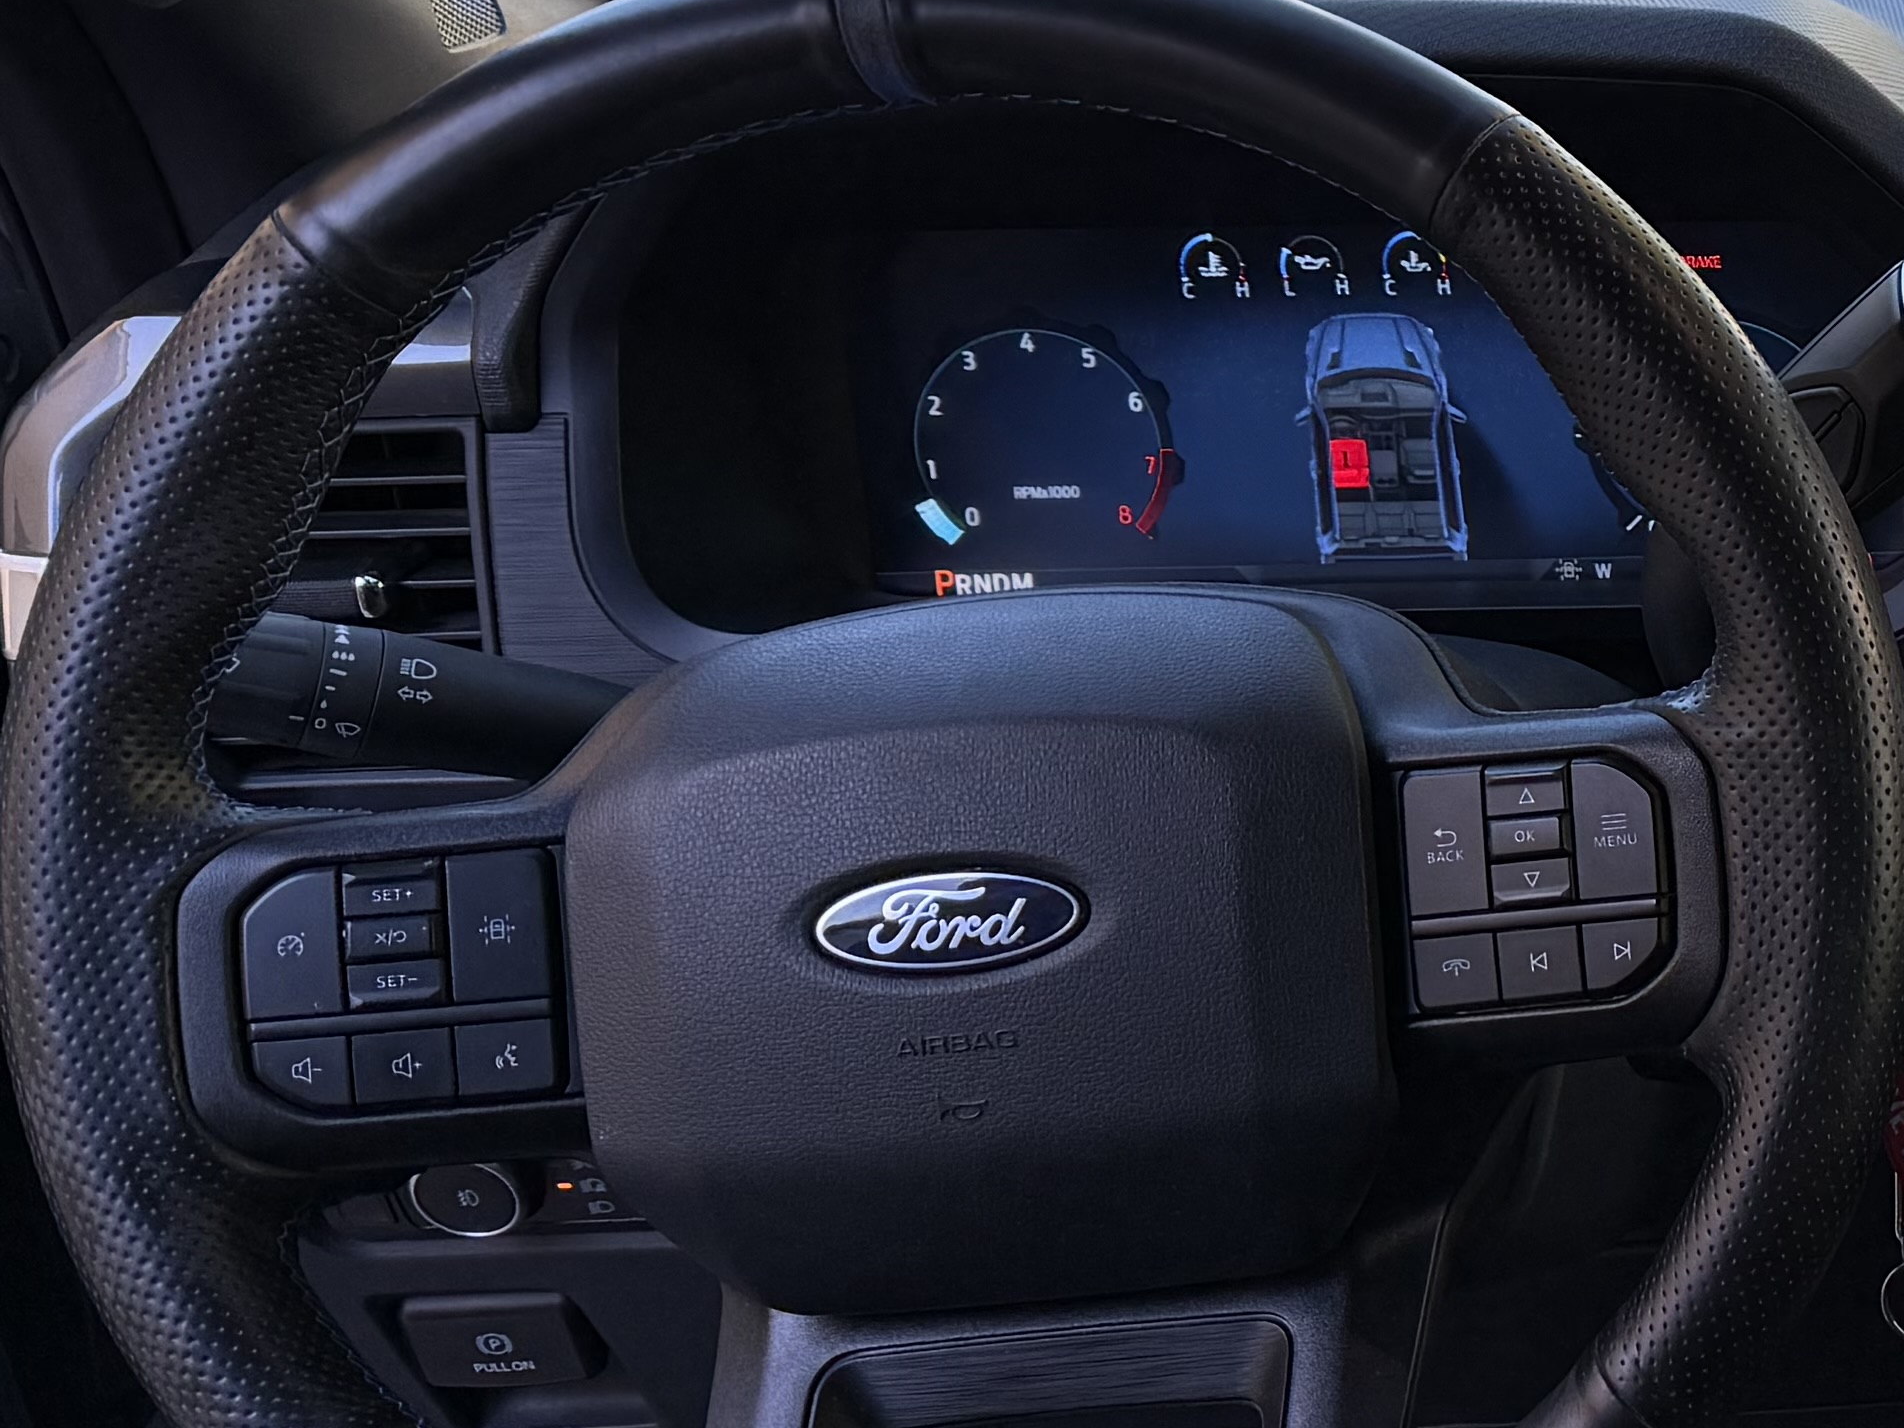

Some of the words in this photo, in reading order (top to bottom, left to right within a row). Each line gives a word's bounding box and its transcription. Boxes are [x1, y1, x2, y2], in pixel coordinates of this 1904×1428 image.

[1182, 283, 1196, 299] C
[1235, 281, 1250, 298] H
[1284, 280, 1296, 297] L
[1335, 279, 1350, 295] H
[1384, 279, 1397, 296] C
[1437, 278, 1452, 295] H
[1019, 332, 1036, 352] 4
[961, 351, 978, 371] 3
[1081, 348, 1098, 368] 5
[926, 395, 944, 416] 2
[1127, 391, 1144, 412] 6
[925, 459, 938, 480] 1
[1143, 456, 1157, 474] 7
[964, 507, 981, 527] 0
[1118, 505, 1133, 524] 8
[1594, 562, 1612, 579] W
[934, 570, 1034, 596] PRNDM
[1514, 830, 1536, 842] OK
[1594, 833, 1638, 848] MENU
[1427, 850, 1464, 864] BACK
[371, 888, 413, 902] SET+
[867, 886, 1028, 955] Ford
[898, 1030, 1019, 1057] AIRBAG
[473, 1362, 511, 1373] PULL
[512, 1360, 536, 1371] ON
